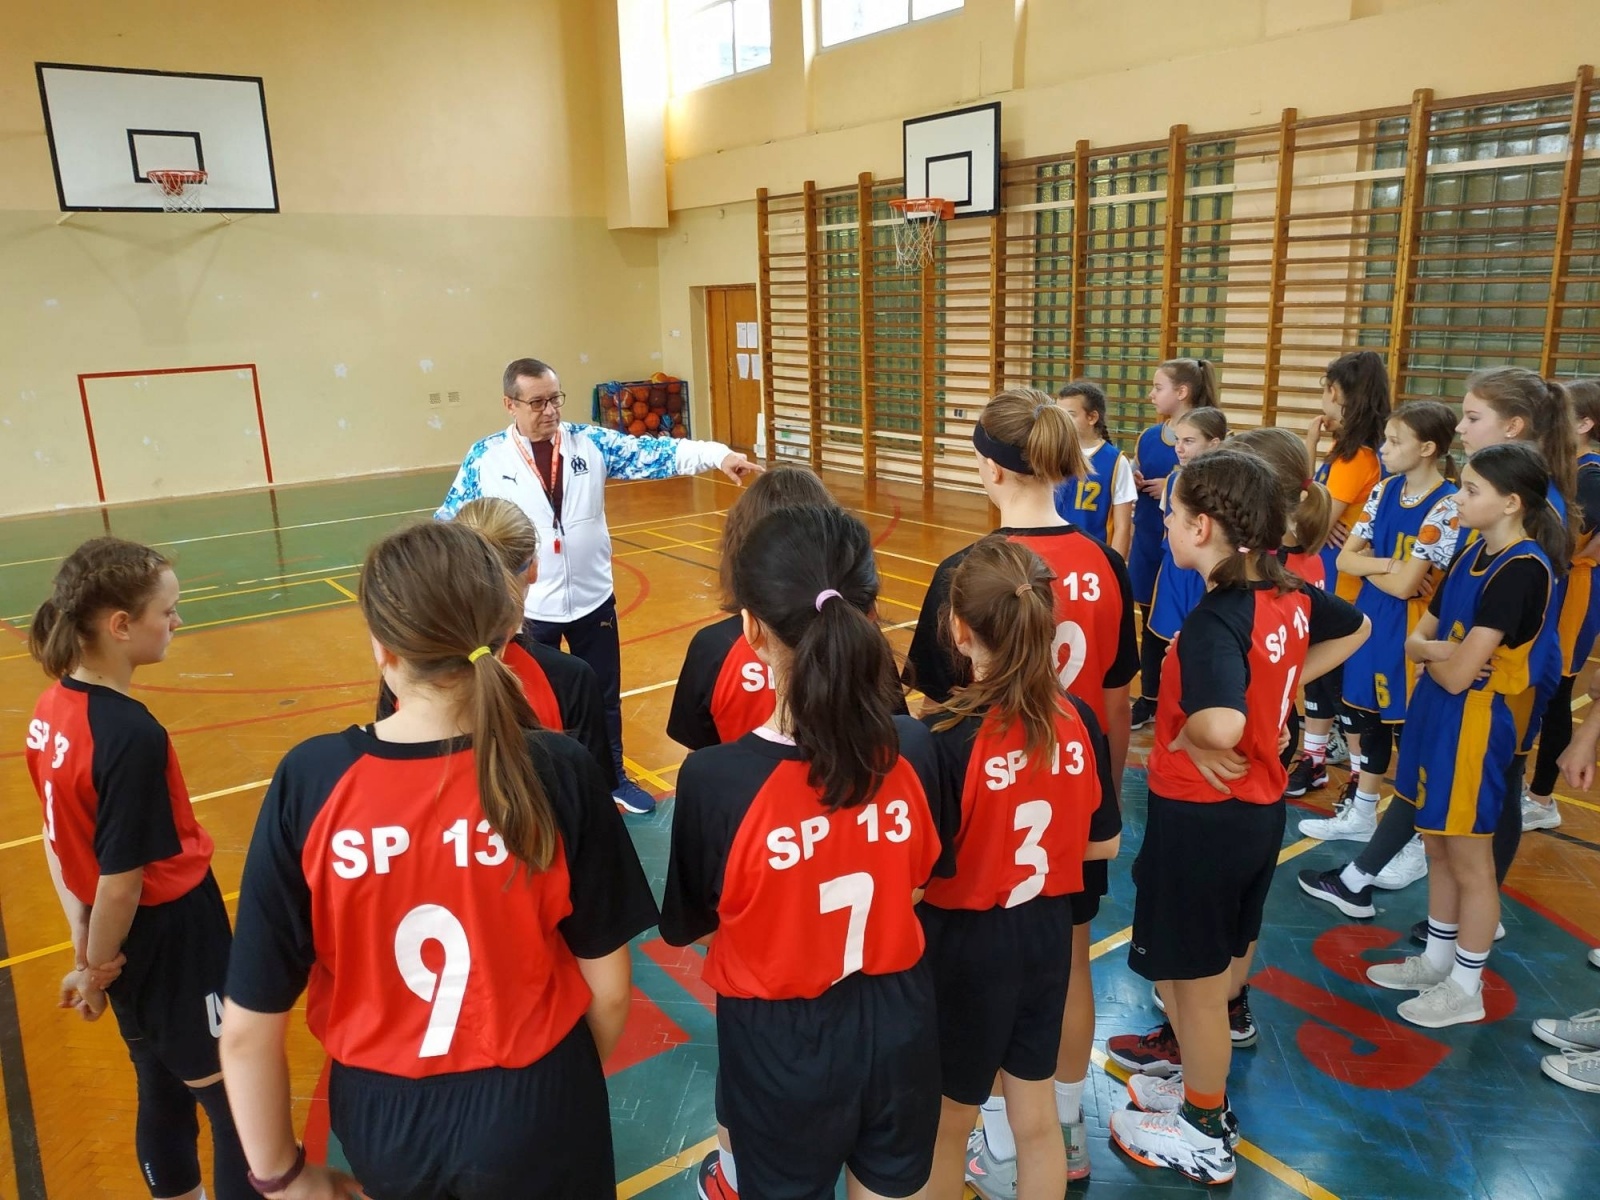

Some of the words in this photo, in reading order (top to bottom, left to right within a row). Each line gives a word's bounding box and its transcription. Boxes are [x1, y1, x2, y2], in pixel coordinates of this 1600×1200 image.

[1074, 480, 1101, 511] 12
[1063, 571, 1101, 602] 13
[1265, 624, 1287, 664] SP
[1374, 673, 1391, 708] 6
[26, 718, 50, 752] SP
[985, 749, 1029, 791] SP
[331, 825, 411, 880] SP
[442, 818, 510, 868] 13
[766, 815, 831, 871] SP
[856, 799, 913, 844] 13
[1005, 799, 1053, 909] 3
[818, 871, 875, 987] 7
[394, 903, 472, 1058] 9
